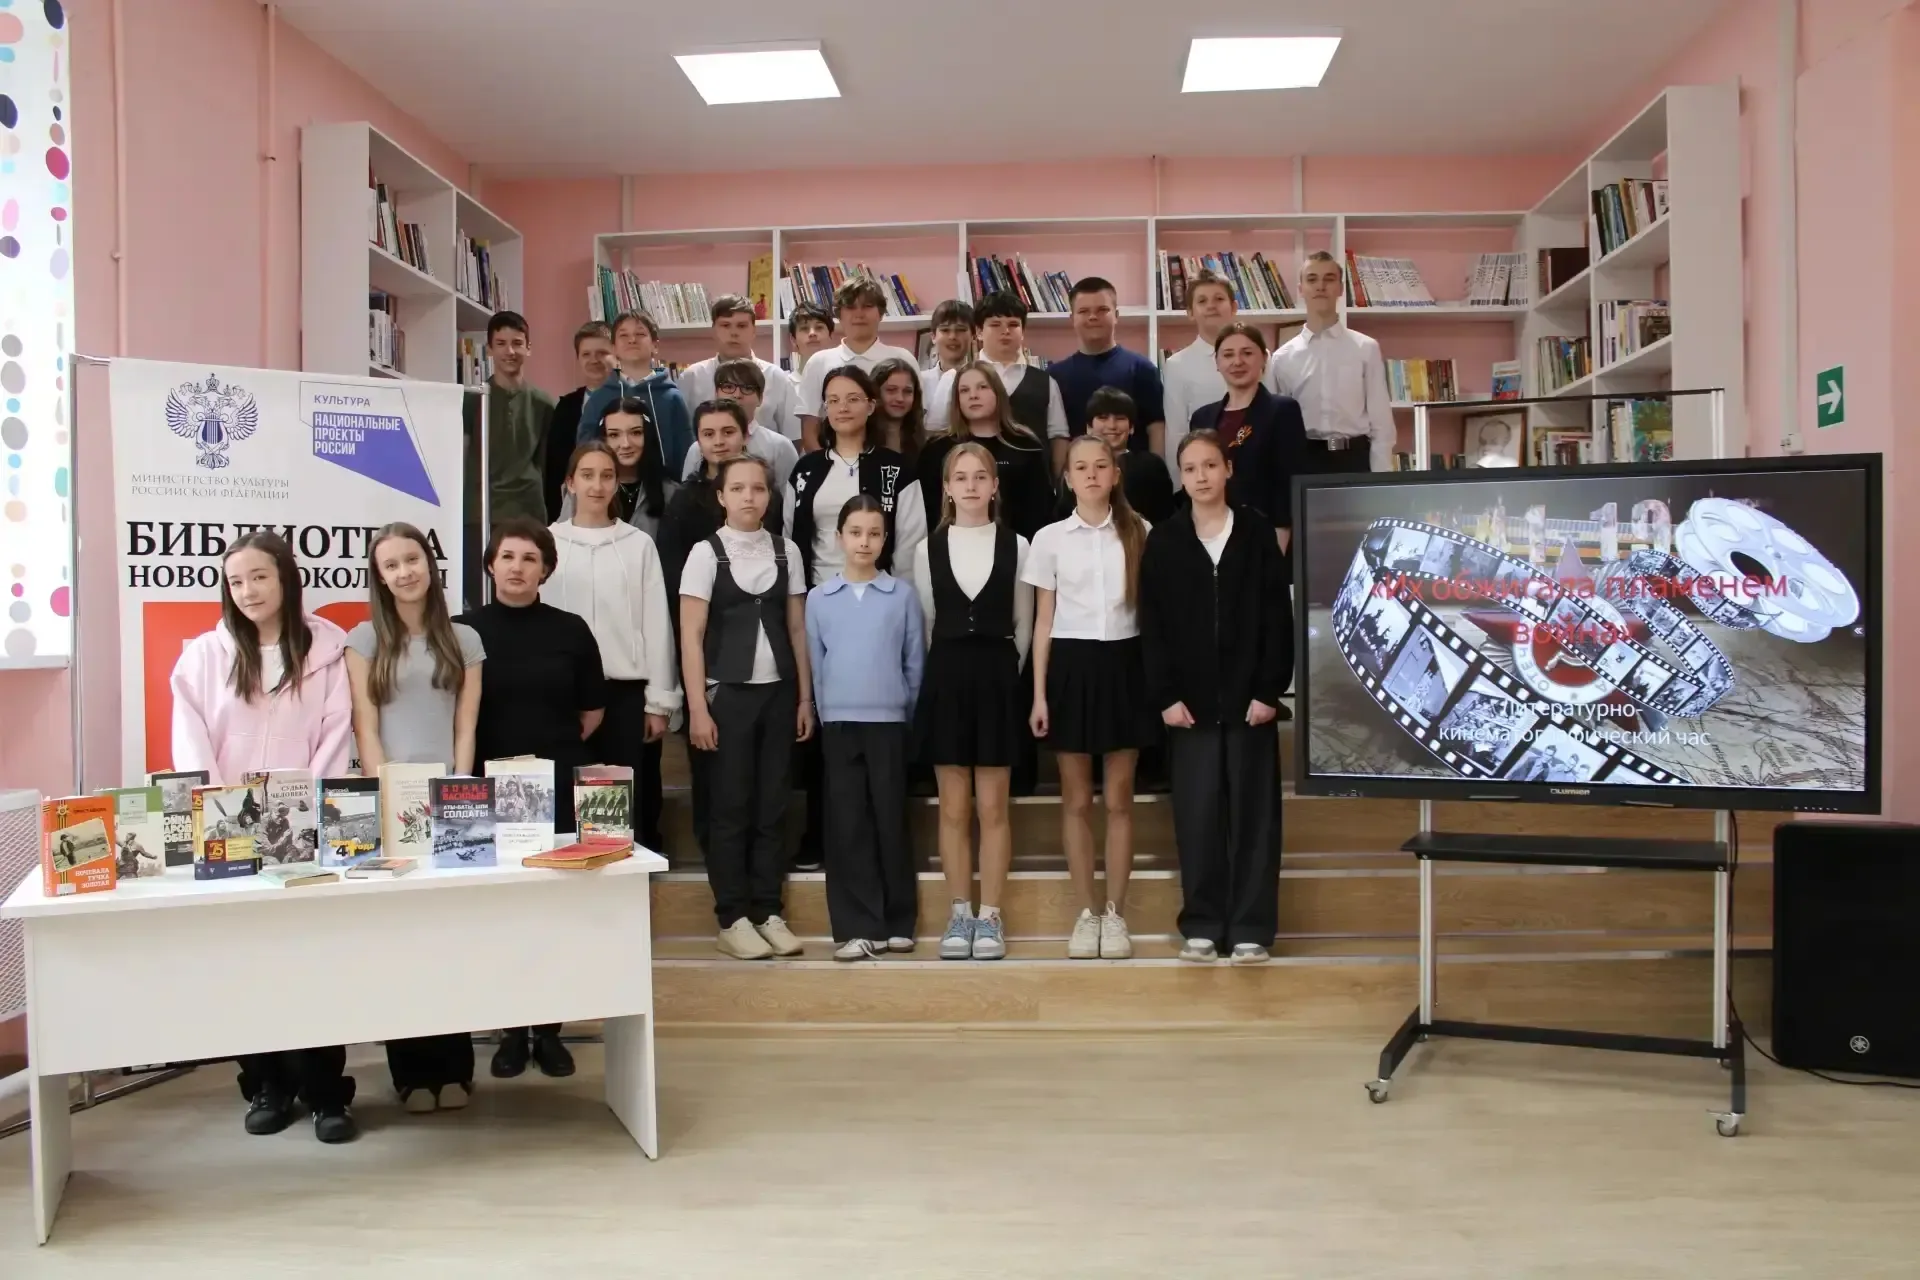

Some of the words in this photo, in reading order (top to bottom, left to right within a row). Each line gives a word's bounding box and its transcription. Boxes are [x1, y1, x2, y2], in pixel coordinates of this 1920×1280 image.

[313, 394, 371, 407] КУЛЬТУРА
[314, 413, 401, 431] НАЦИОНАЛЬНЫЕ
[314, 427, 365, 442] ПРОЕКТЫ
[314, 440, 356, 455] РОССИИ
[131, 473, 230, 486] МИНИСТЕРСТВО
[233, 476, 290, 488] КУЛЬТУРЫ
[220, 487, 290, 500] ФЕДЕРАЦИИ
[126, 521, 449, 561] БИБИОТА
[1431, 567, 1596, 600] обжигала
[1605, 574, 1787, 600] пламенем
[1500, 700, 1643, 722] Литературно-
[1438, 724, 1671, 746] кинематогфический
[1676, 730, 1712, 746] час
[270, 790, 309, 799] ЧЕЛОВЕКА
[281, 784, 309, 792] СУДЬБА
[443, 810, 489, 819] СОЛДАТЫ
